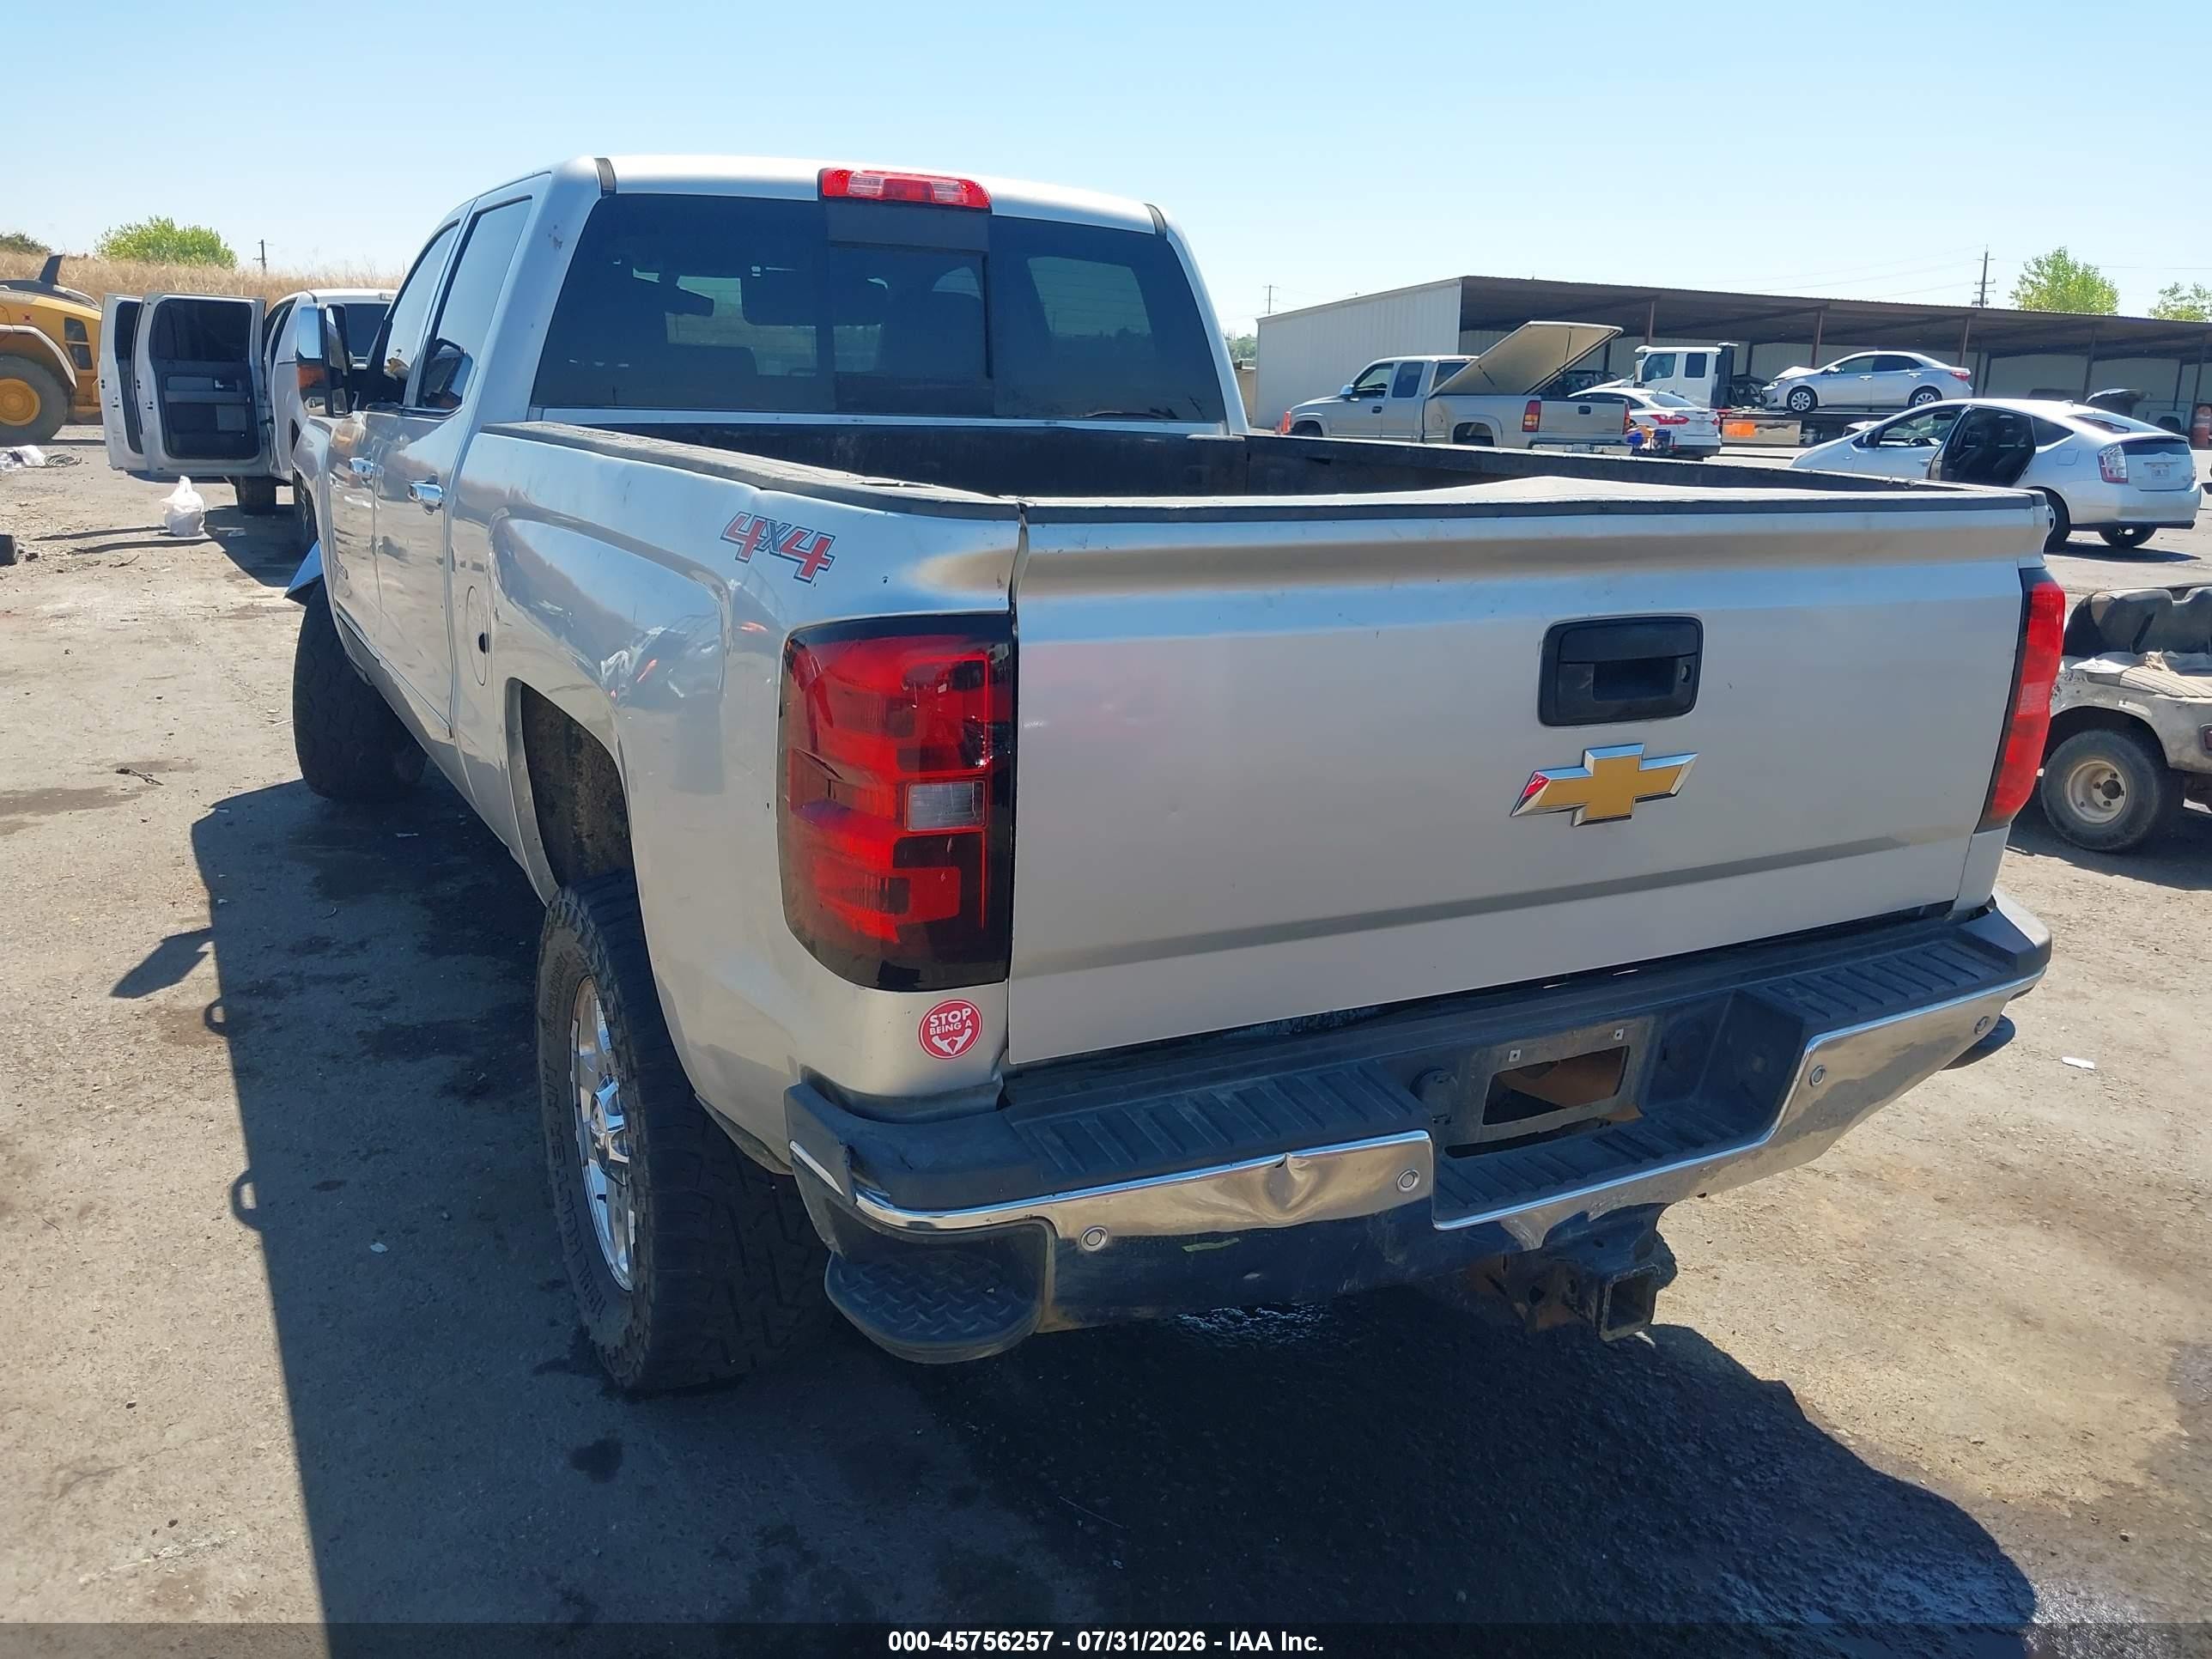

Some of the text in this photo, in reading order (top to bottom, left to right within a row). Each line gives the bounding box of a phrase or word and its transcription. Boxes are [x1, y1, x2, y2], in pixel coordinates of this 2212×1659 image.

[929, 1007, 972, 1028] STOP
[929, 1019, 973, 1036] BEING A
